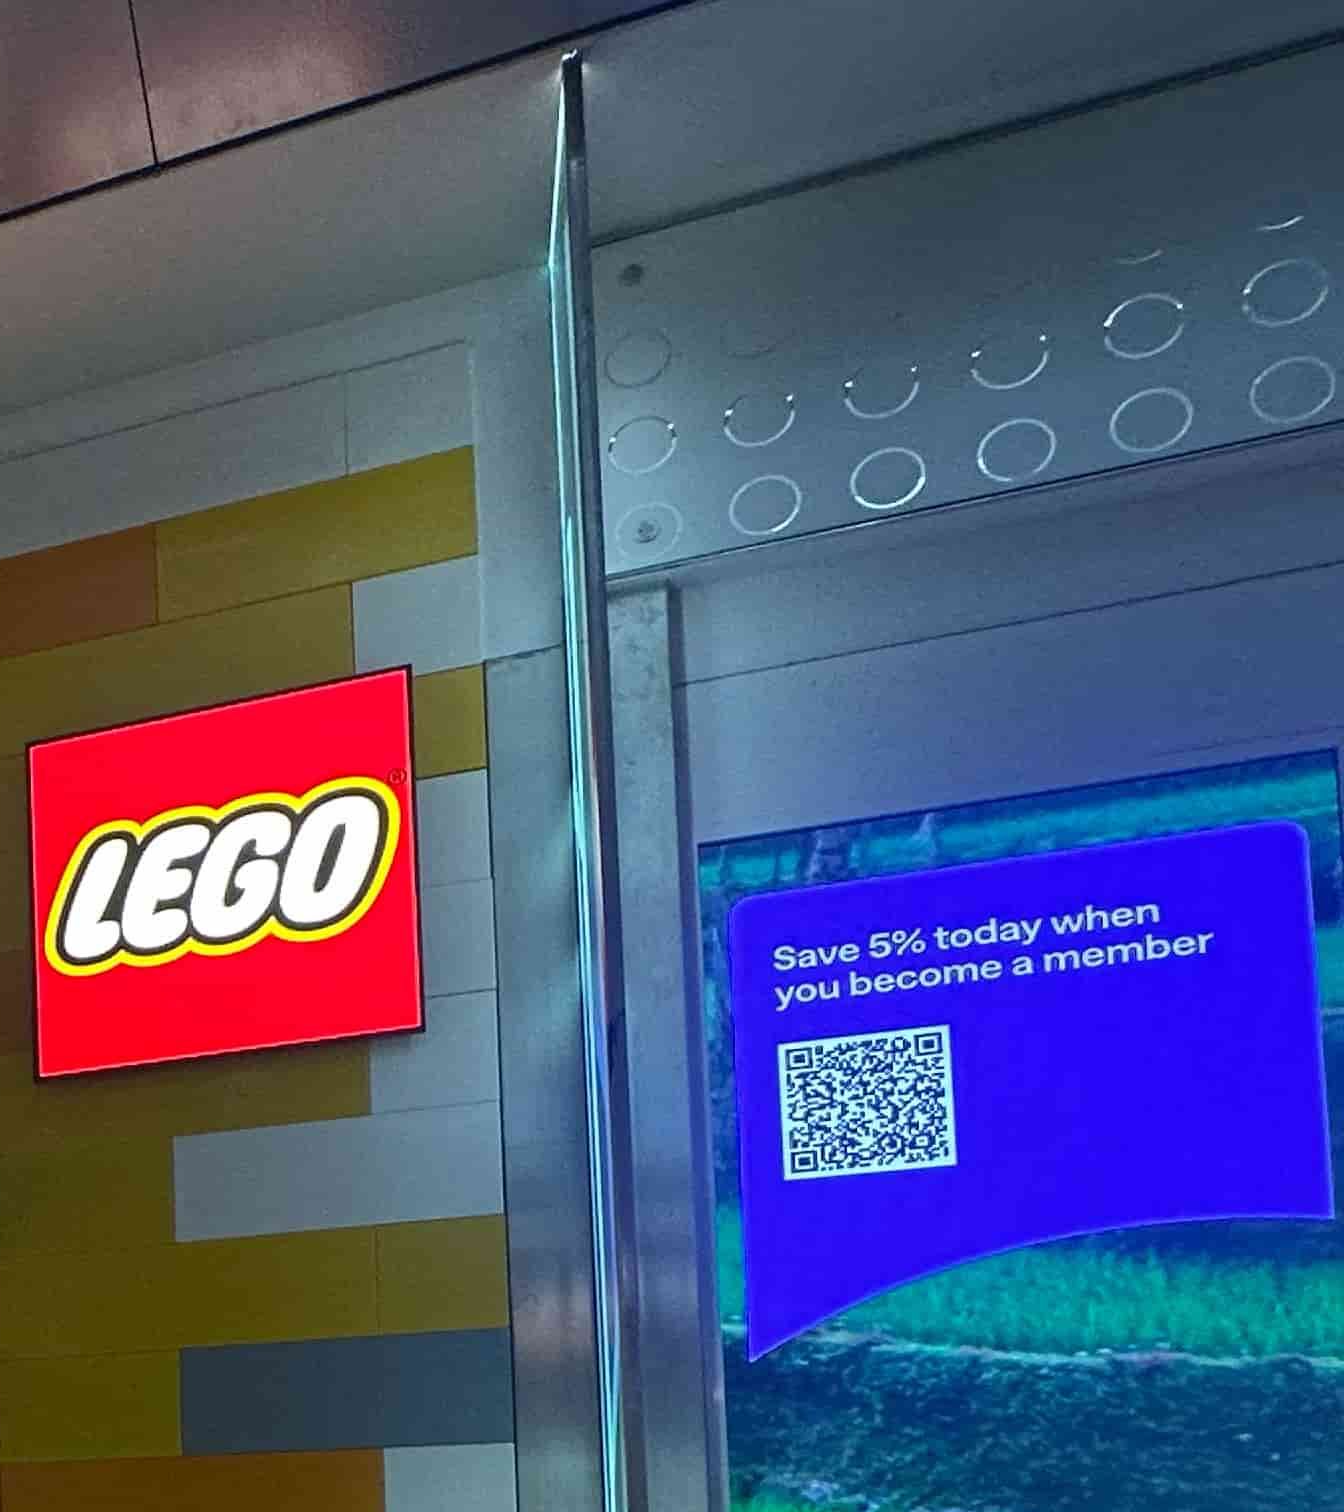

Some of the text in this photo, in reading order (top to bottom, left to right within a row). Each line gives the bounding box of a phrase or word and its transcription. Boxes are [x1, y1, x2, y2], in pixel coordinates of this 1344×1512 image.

[55, 786, 390, 967] LEGO
[773, 903, 1161, 971] Save 5% today when
[774, 932, 1215, 1012] you become a member
